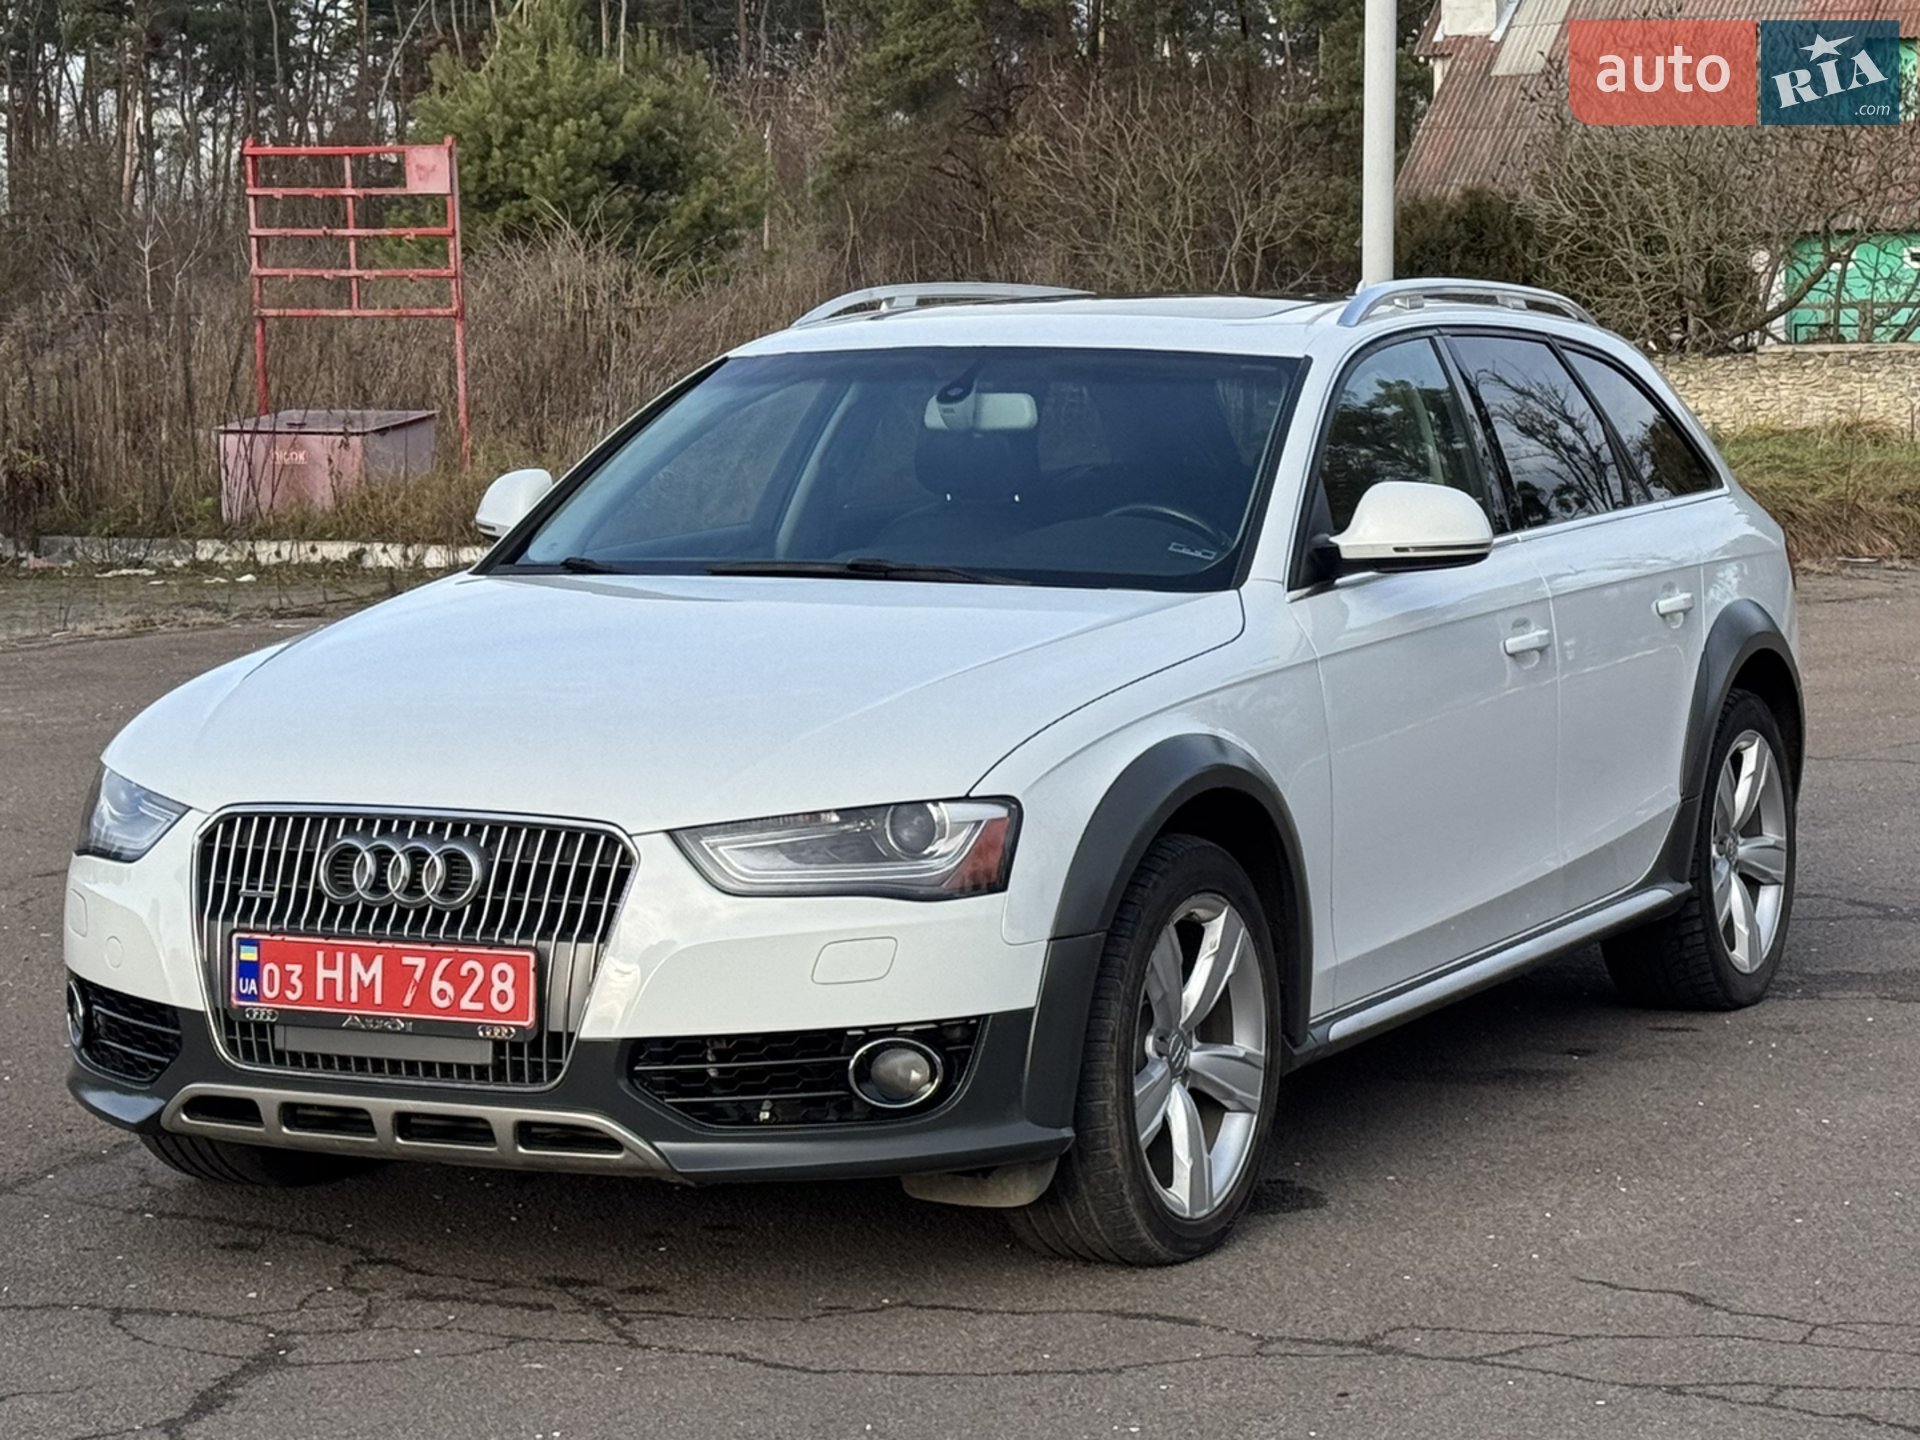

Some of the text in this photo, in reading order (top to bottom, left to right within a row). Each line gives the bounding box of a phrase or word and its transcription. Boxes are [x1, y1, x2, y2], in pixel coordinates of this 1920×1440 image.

[239, 977, 258, 995] UA
[262, 950, 515, 1013] 03 HM 7628
